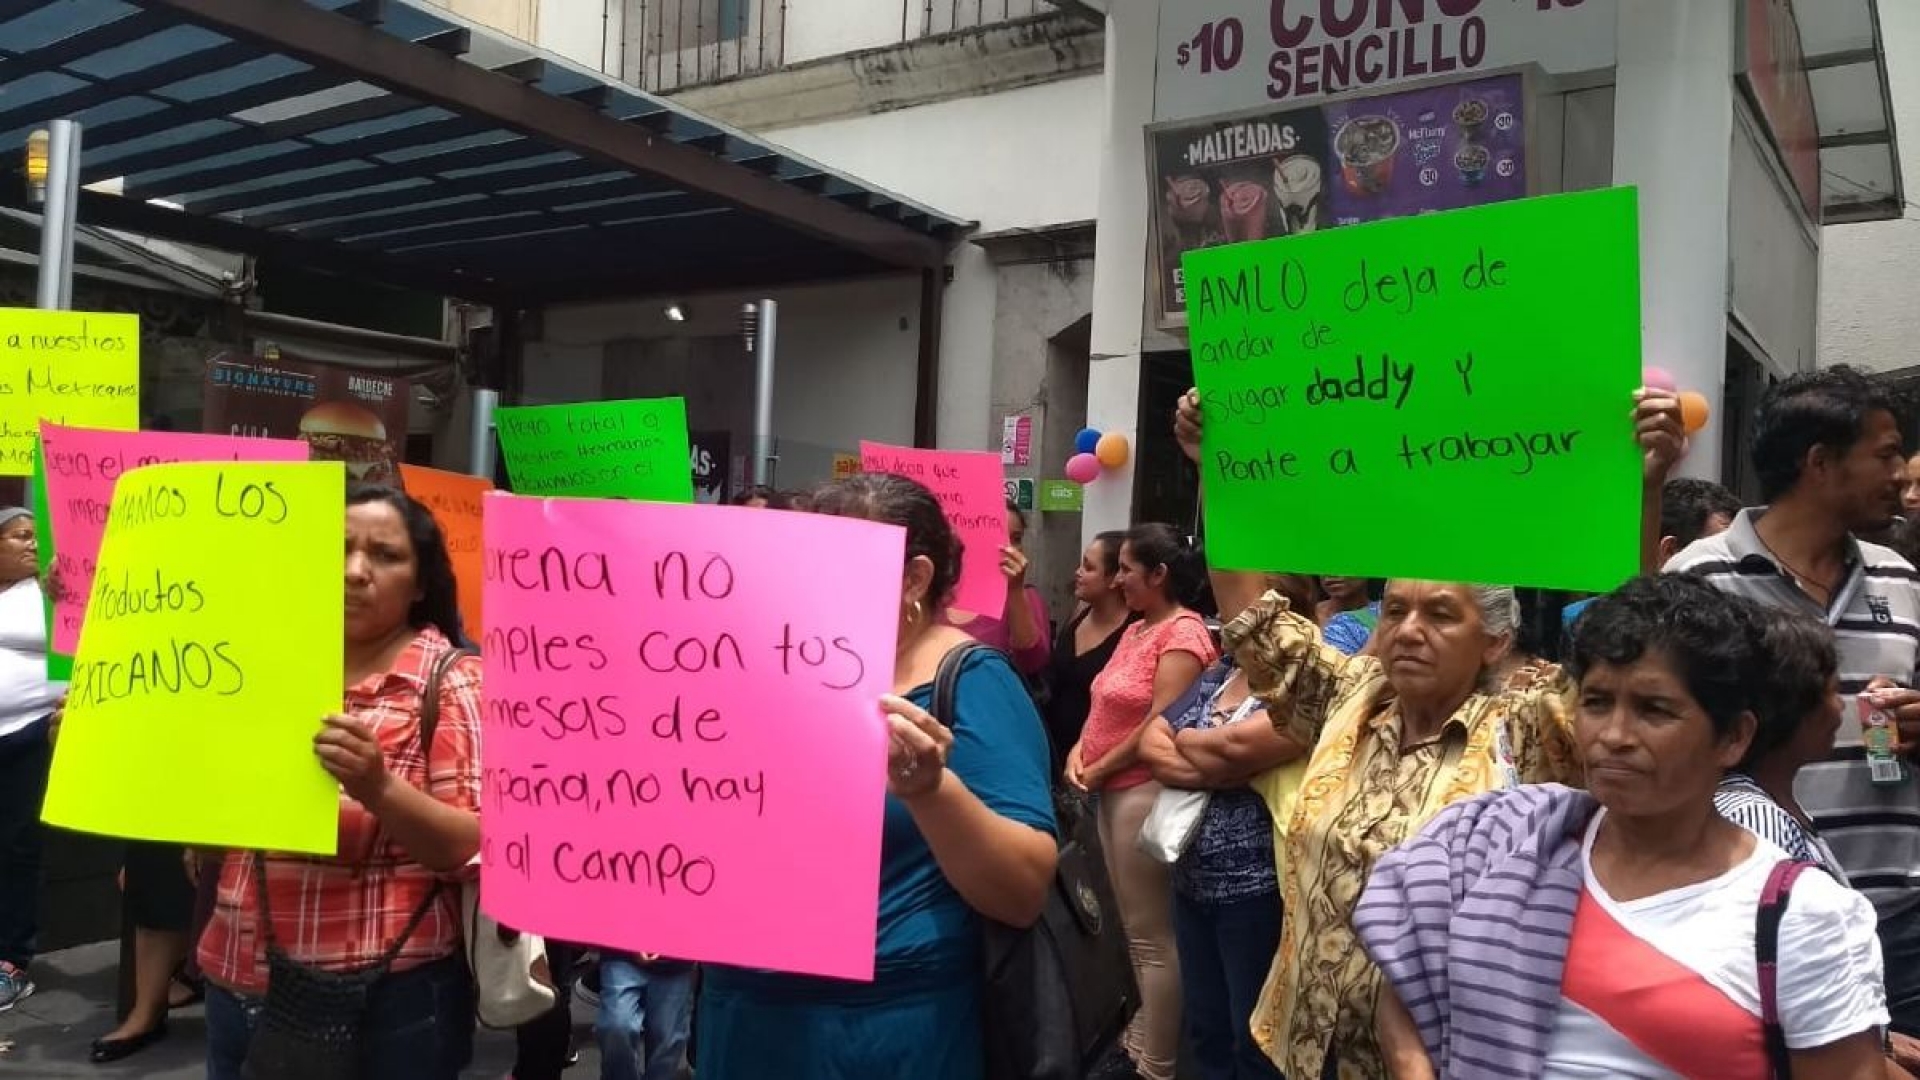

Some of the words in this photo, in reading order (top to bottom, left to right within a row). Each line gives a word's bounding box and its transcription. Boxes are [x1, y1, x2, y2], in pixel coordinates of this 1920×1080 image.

[1176, 17, 1244, 74] $10
[1267, 16, 1486, 99] SENCILLO
[1188, 122, 1296, 166] MALTEADAS
[1199, 257, 1308, 324] AMLO
[1343, 258, 1438, 314] deja
[1463, 247, 1508, 291] de
[1201, 326, 1275, 364] andar
[1302, 319, 1339, 350] de
[1306, 353, 1415, 409] daddy
[566, 409, 625, 435] total
[1217, 449, 1299, 482] Ponte
[1329, 448, 1358, 474] a
[1397, 429, 1584, 475] trabajar
[216, 472, 287, 525] LOS
[654, 550, 734, 601] no
[639, 631, 746, 673] con
[652, 696, 728, 742] de
[683, 767, 765, 817] hay
